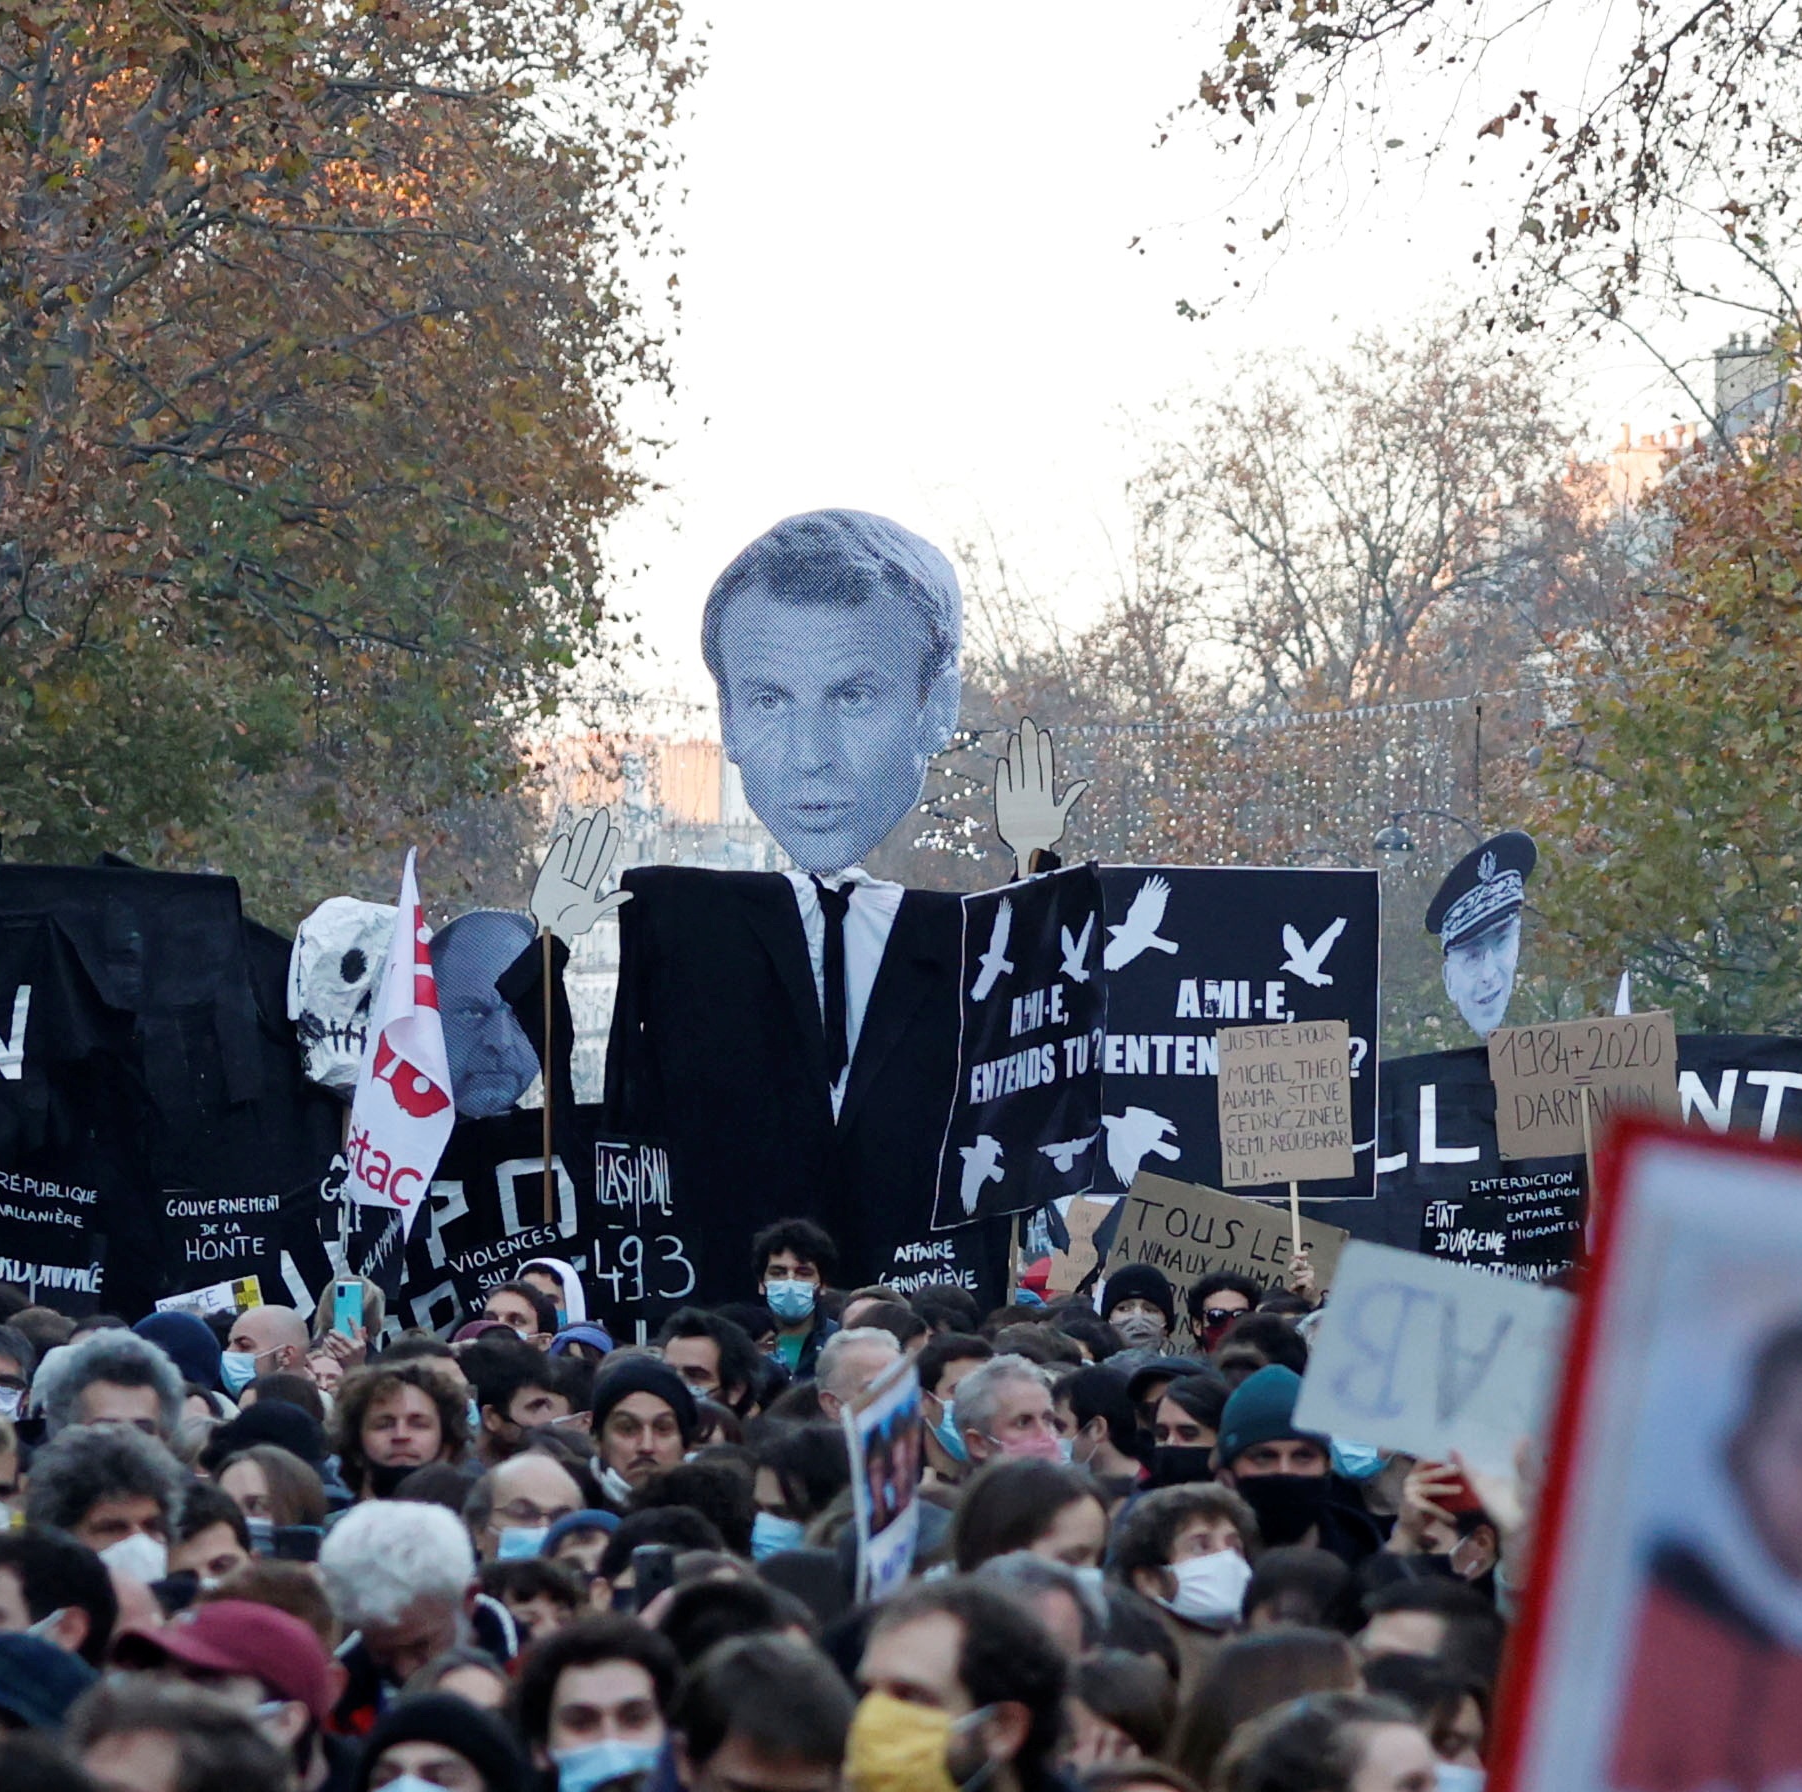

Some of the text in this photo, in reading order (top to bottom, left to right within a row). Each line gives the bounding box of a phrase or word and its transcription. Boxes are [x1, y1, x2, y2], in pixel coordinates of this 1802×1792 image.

[1222, 1024, 1335, 1052] JUSTICE POUR
[969, 1042, 1056, 1105] ENTENDS
[1063, 1034, 1089, 1079] TU
[1104, 1034, 1220, 1078] ENTEN
[1227, 1058, 1344, 1085] MICHEL, THEO,
[1287, 1082, 1342, 1105] STEVE
[1295, 1106, 1347, 1129] ZINEB
[166, 1194, 280, 1218] GOUVERNEMENT
[200, 1222, 241, 1237] DE LA
[1132, 1197, 1245, 1250] TOUS
[185, 1236, 265, 1262] HONTE
[594, 1235, 696, 1303] 49.3
